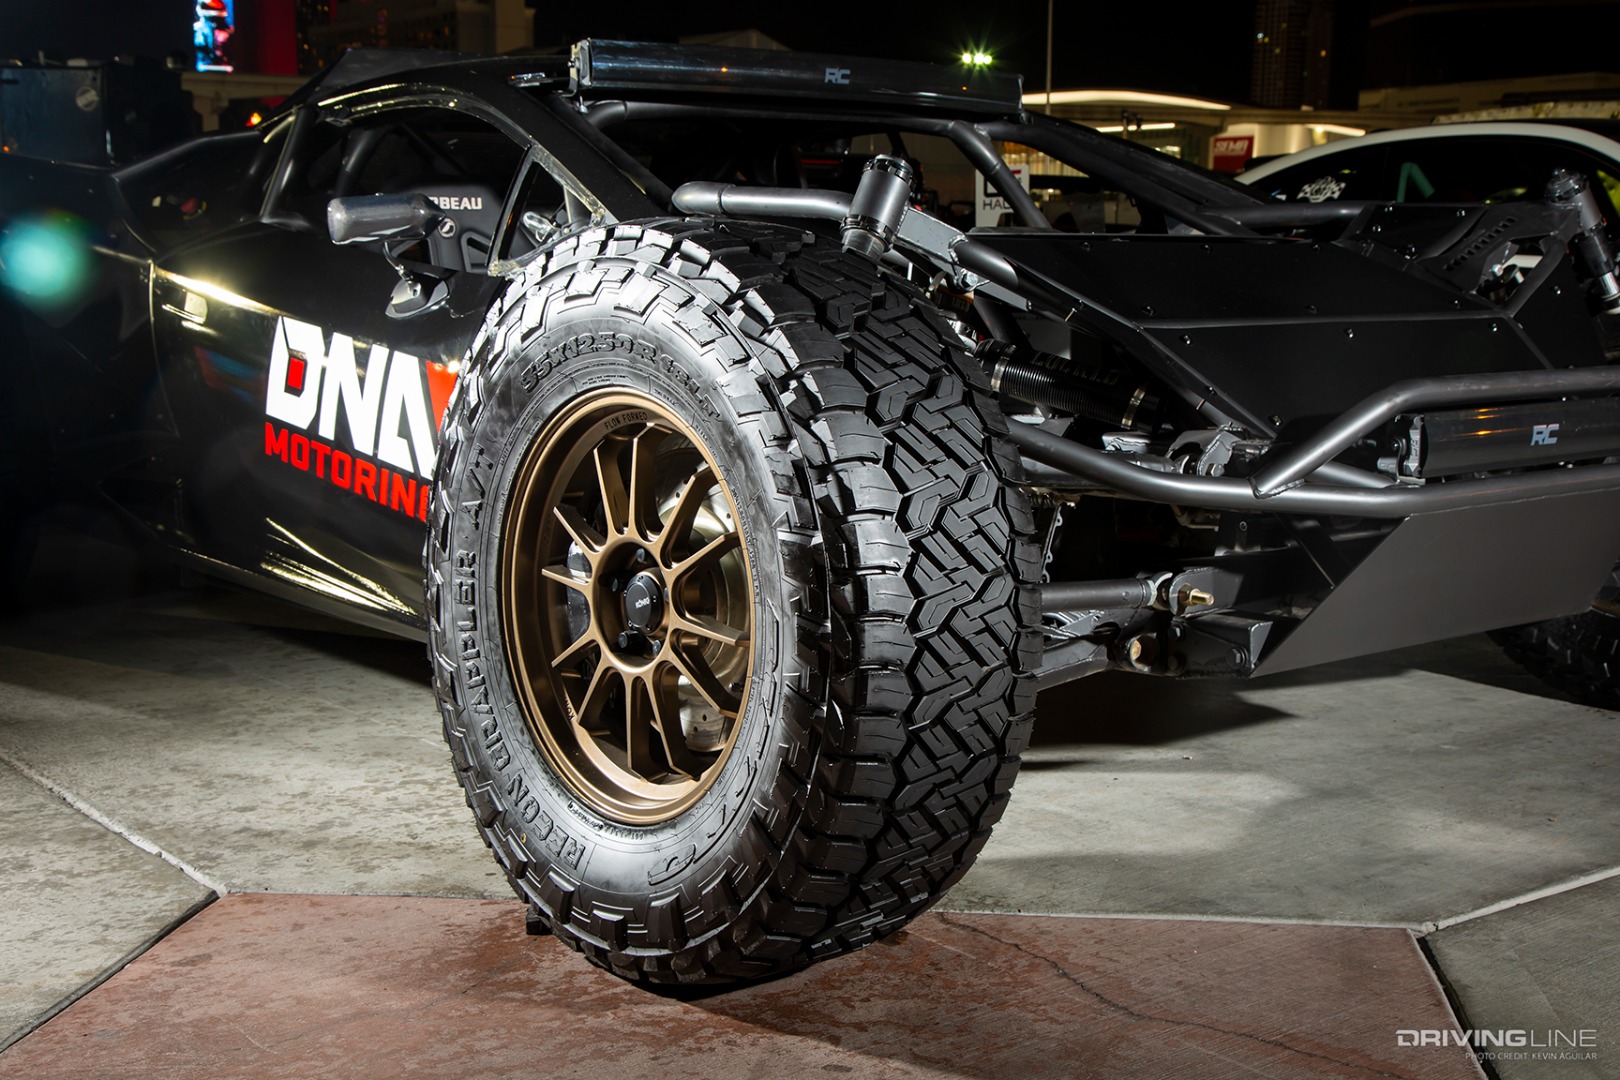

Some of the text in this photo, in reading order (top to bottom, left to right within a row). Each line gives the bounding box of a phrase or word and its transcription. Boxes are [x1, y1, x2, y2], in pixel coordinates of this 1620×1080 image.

[824, 67, 851, 85] RC
[265, 315, 433, 481] DNA
[604, 411, 648, 431] FLOW FORMED
[1530, 423, 1560, 447] RC
[455, 550, 511, 772] GRAPPLER
[505, 773, 586, 870] RECON
